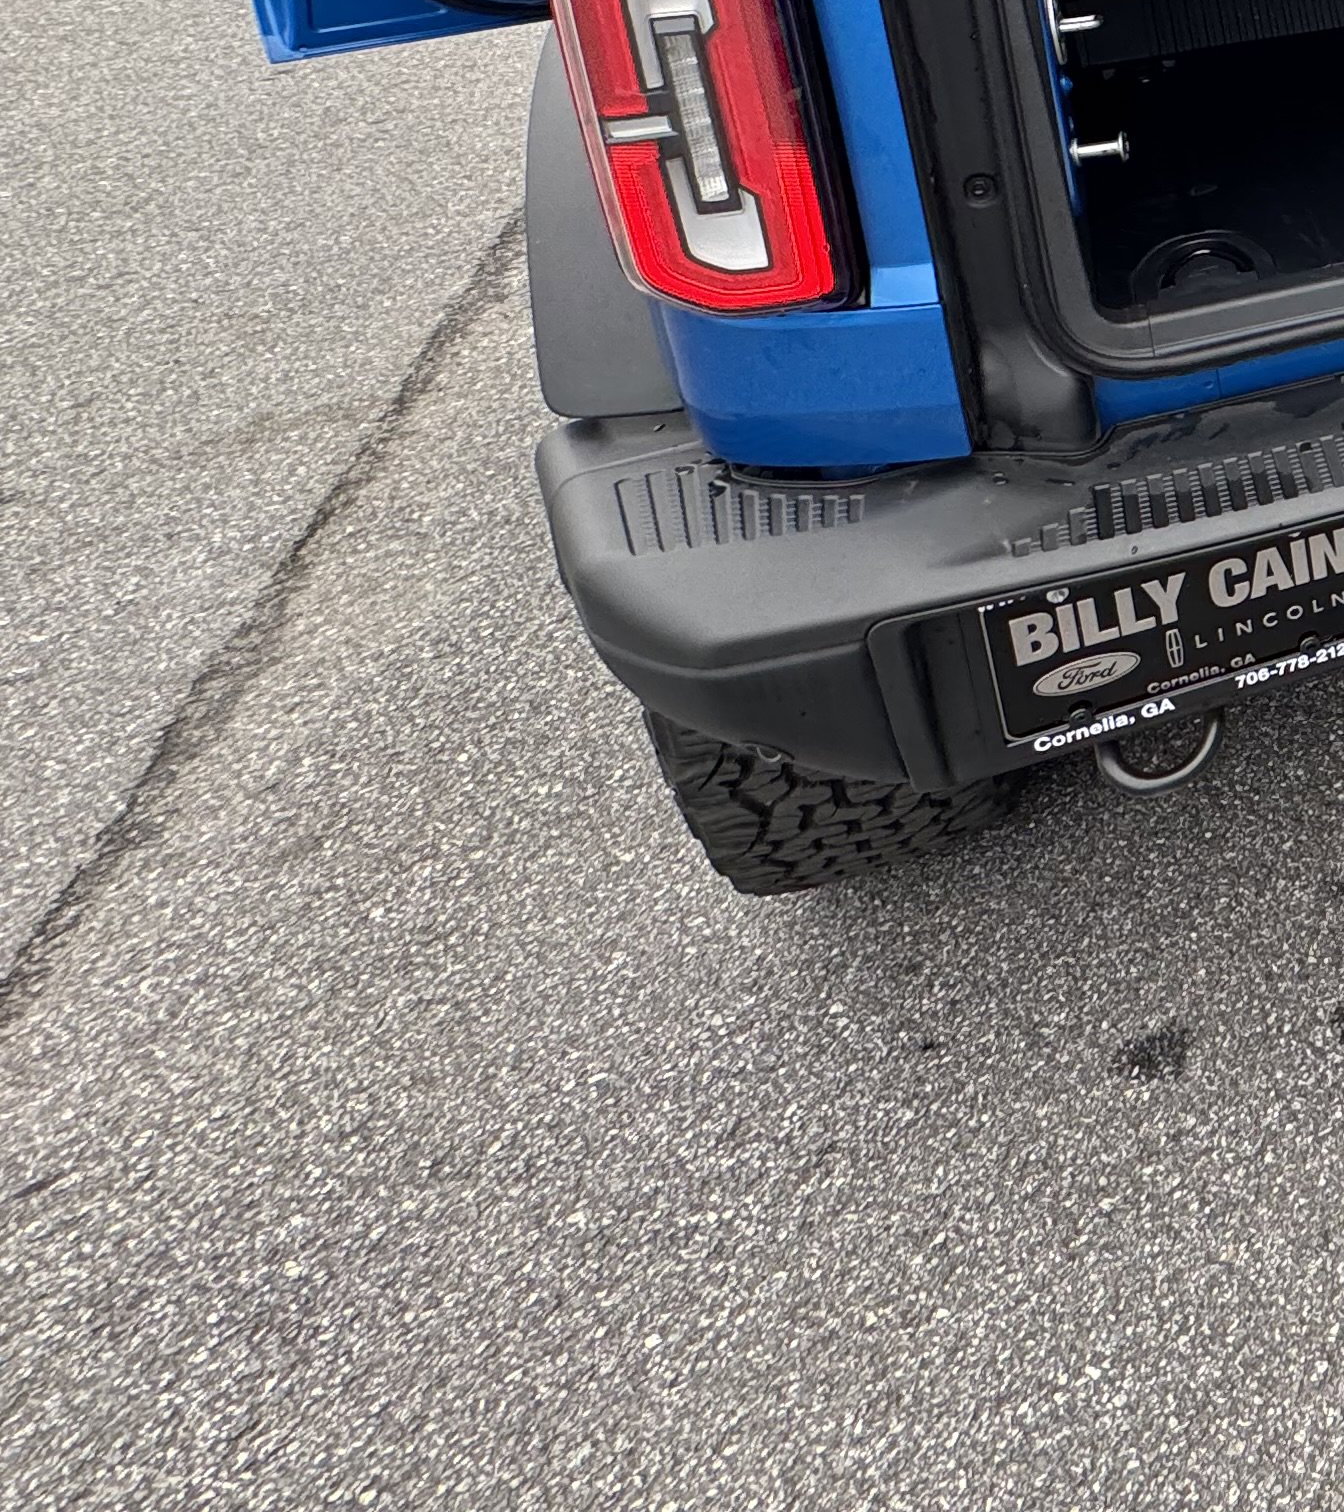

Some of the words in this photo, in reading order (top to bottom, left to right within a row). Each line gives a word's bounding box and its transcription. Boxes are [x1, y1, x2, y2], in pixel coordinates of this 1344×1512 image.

[1008, 572, 1186, 666] BILLY
[1230, 653, 1256, 669] GA
[1141, 698, 1175, 718] GA
